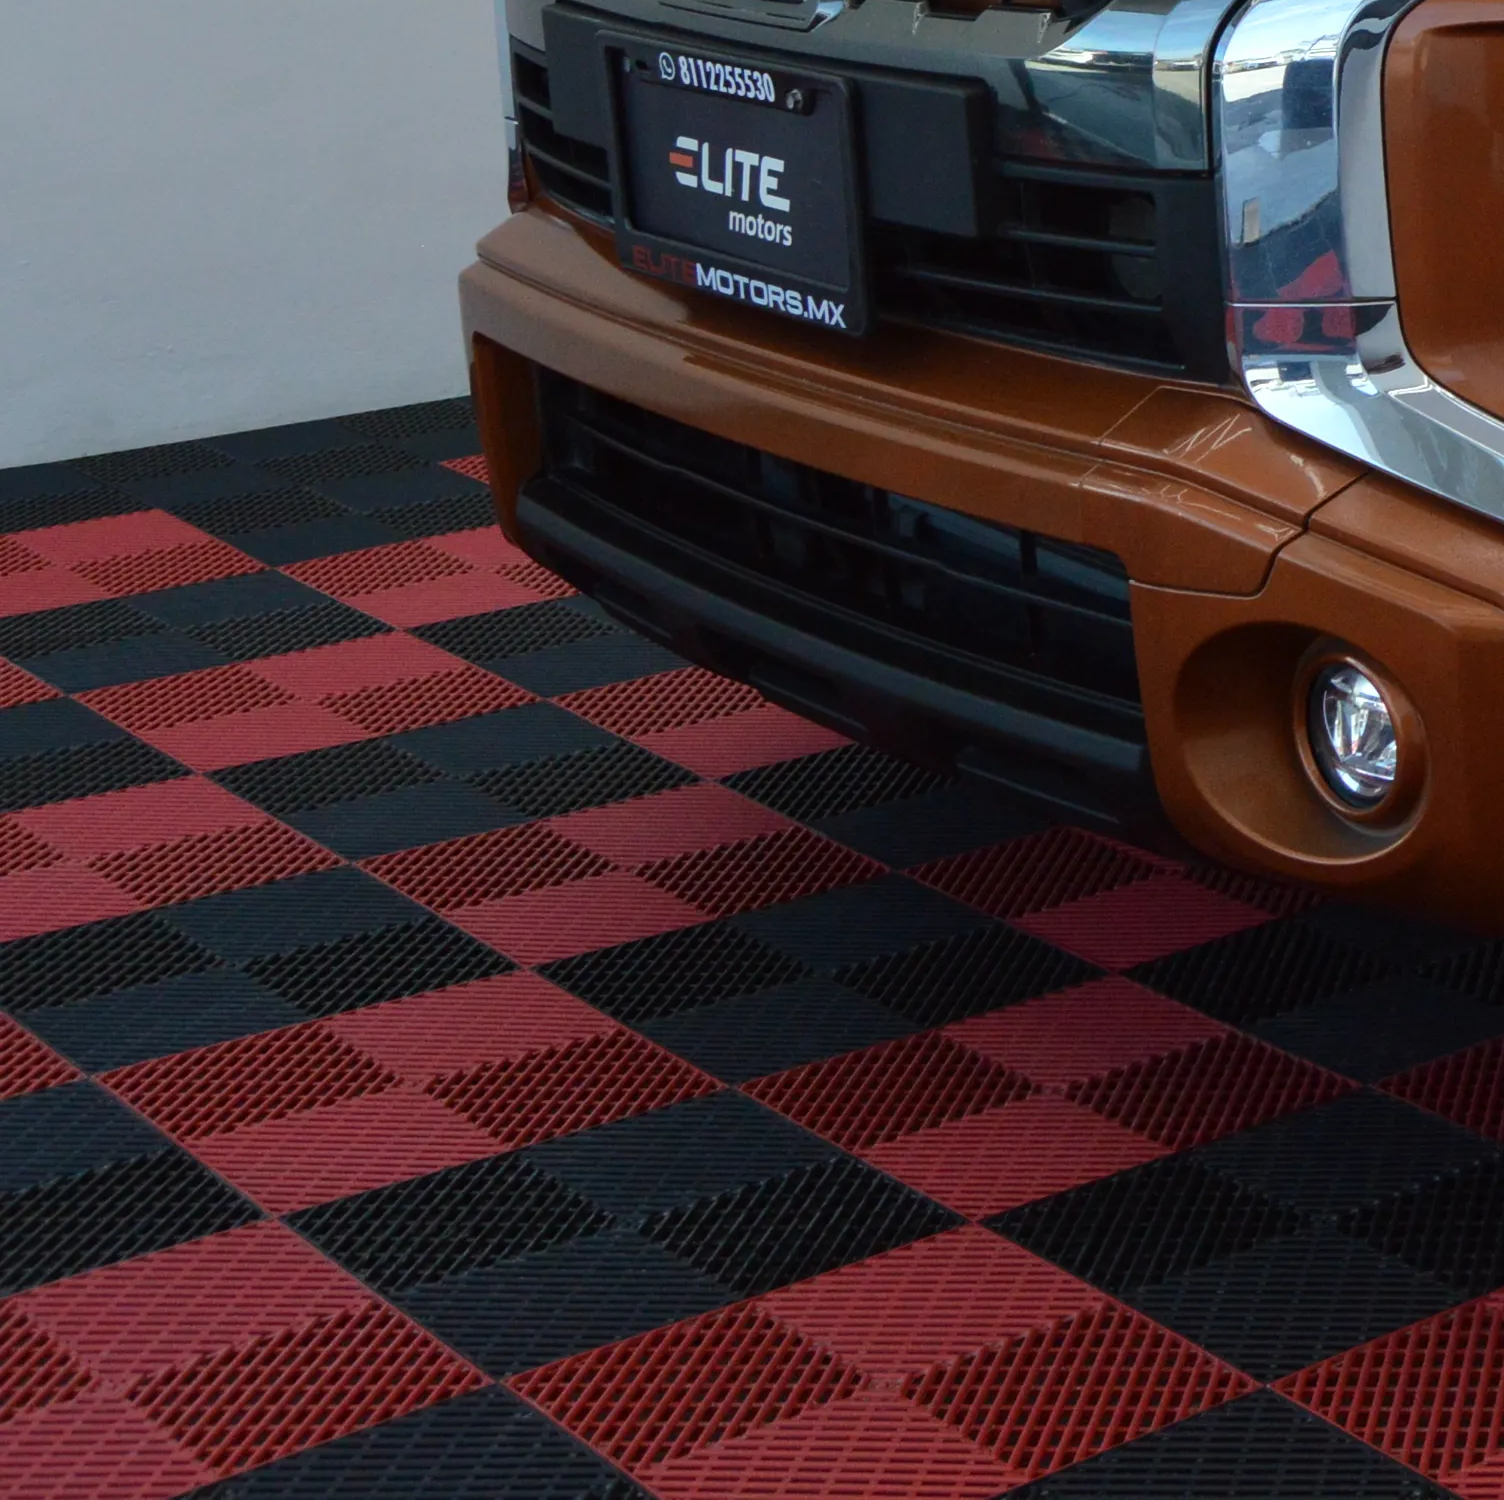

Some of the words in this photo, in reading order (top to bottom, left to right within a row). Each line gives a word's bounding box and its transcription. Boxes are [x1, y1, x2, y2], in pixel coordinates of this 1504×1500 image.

[678, 55, 775, 102] 8112255530
[669, 136, 791, 212] ELITE
[729, 210, 793, 246] motors
